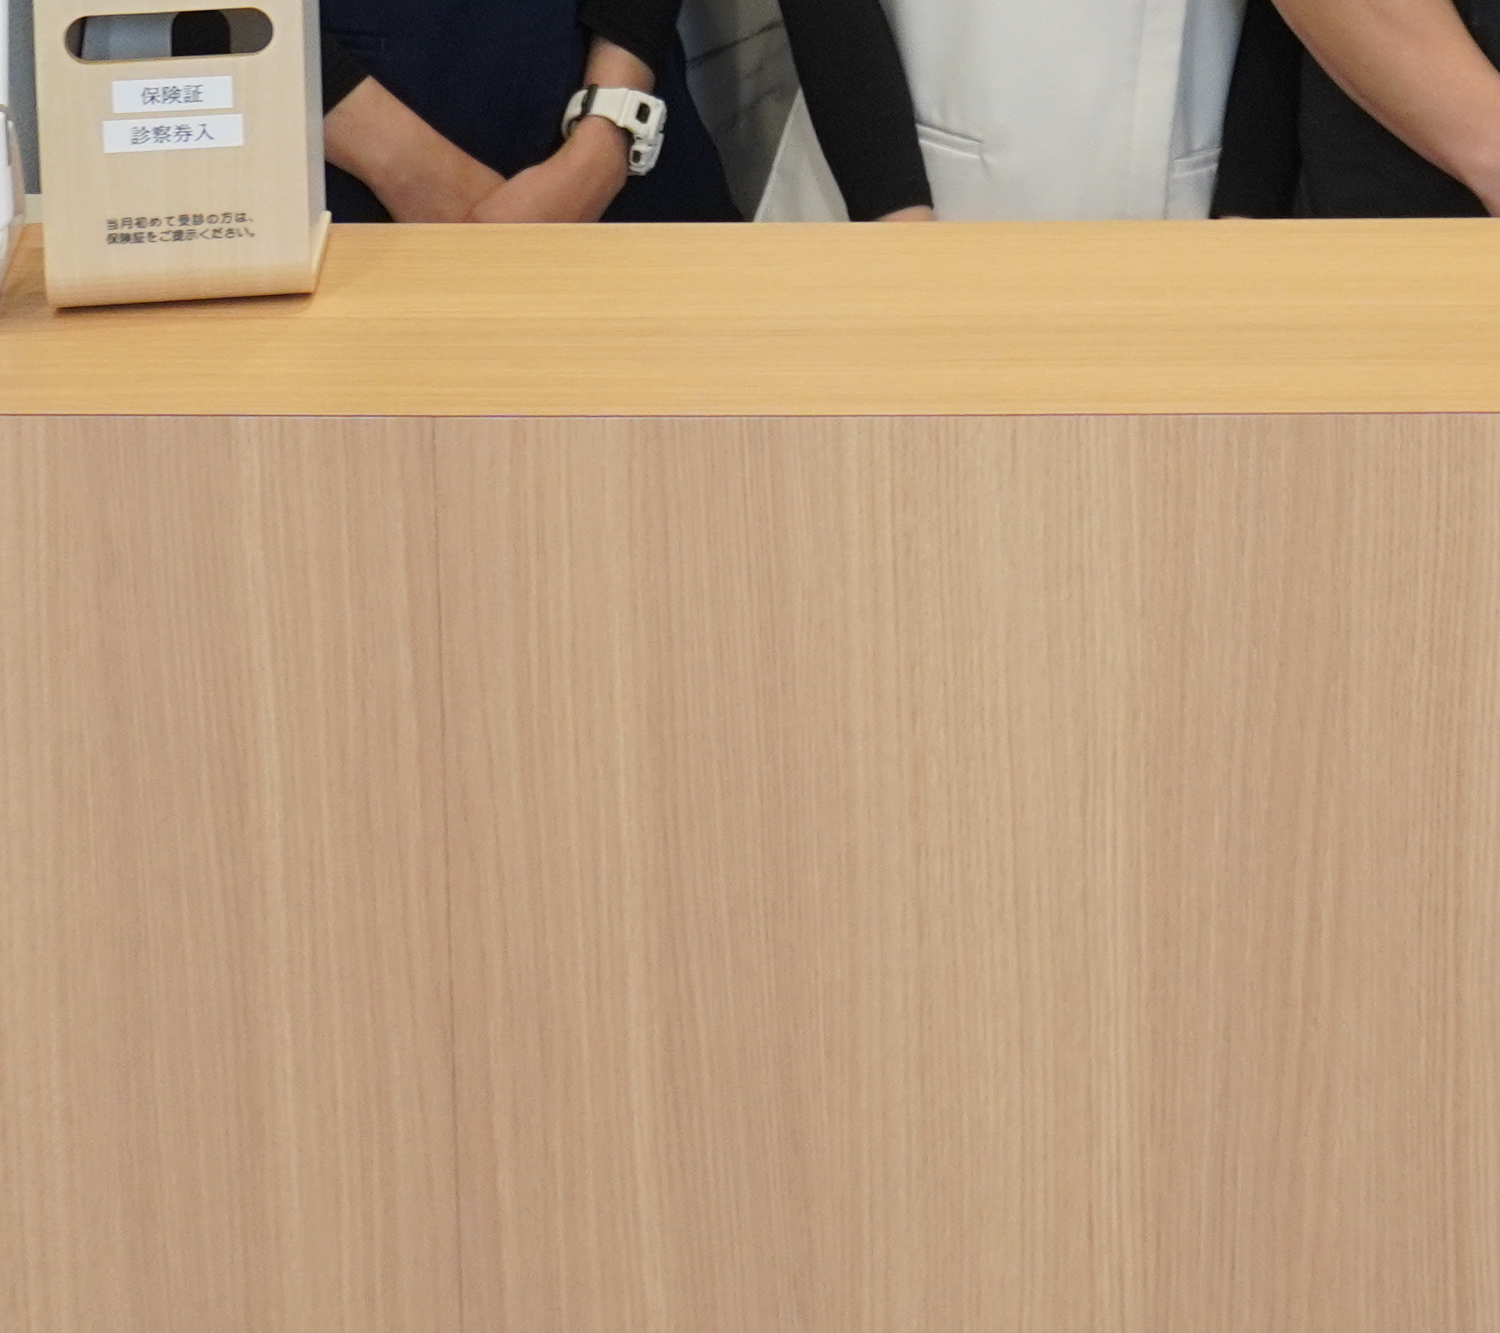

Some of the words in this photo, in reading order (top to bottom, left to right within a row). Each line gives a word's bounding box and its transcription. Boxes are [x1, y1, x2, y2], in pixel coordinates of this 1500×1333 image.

[141, 84, 204, 106] 保険証
[130, 123, 215, 146] 診察券入
[106, 212, 254, 231] 当月初めて受診の方は、
[106, 227, 256, 245] 保険証をご提示ください。
